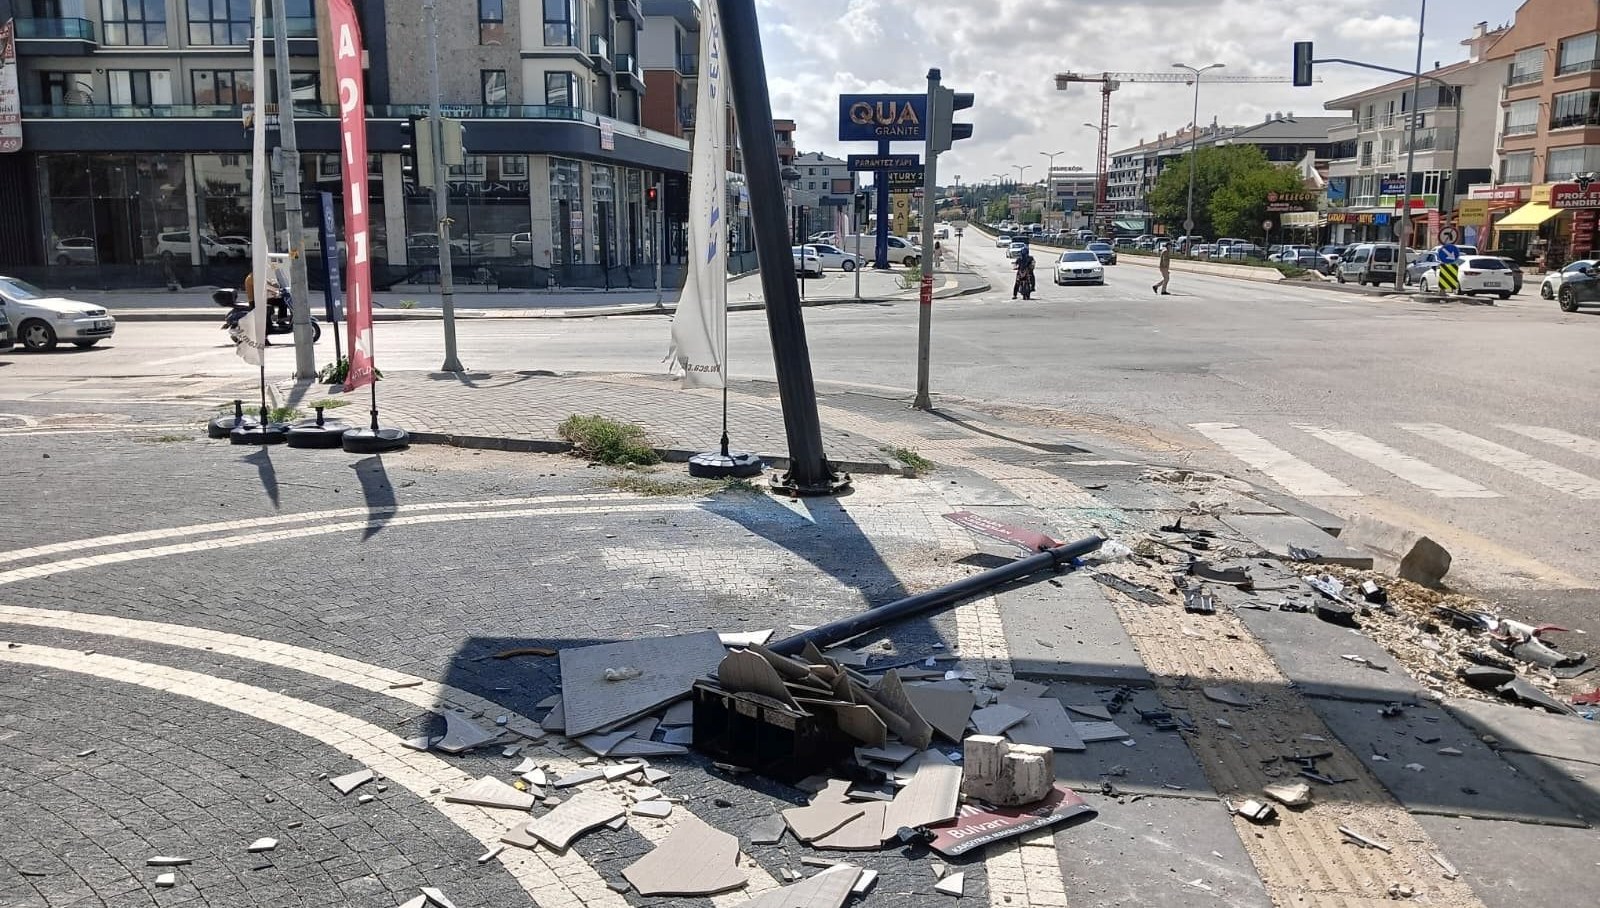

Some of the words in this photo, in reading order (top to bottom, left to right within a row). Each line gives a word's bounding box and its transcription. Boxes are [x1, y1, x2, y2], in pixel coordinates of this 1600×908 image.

[850, 101, 919, 125] QUA
[875, 126, 920, 136] GRANITE
[855, 159, 894, 167] PARANTEZ
[894, 159, 912, 167] YAPI
[877, 172, 917, 180] NTURY
[1557, 192, 1587, 200] PROF.
[947, 819, 1010, 839] Bulvarı
